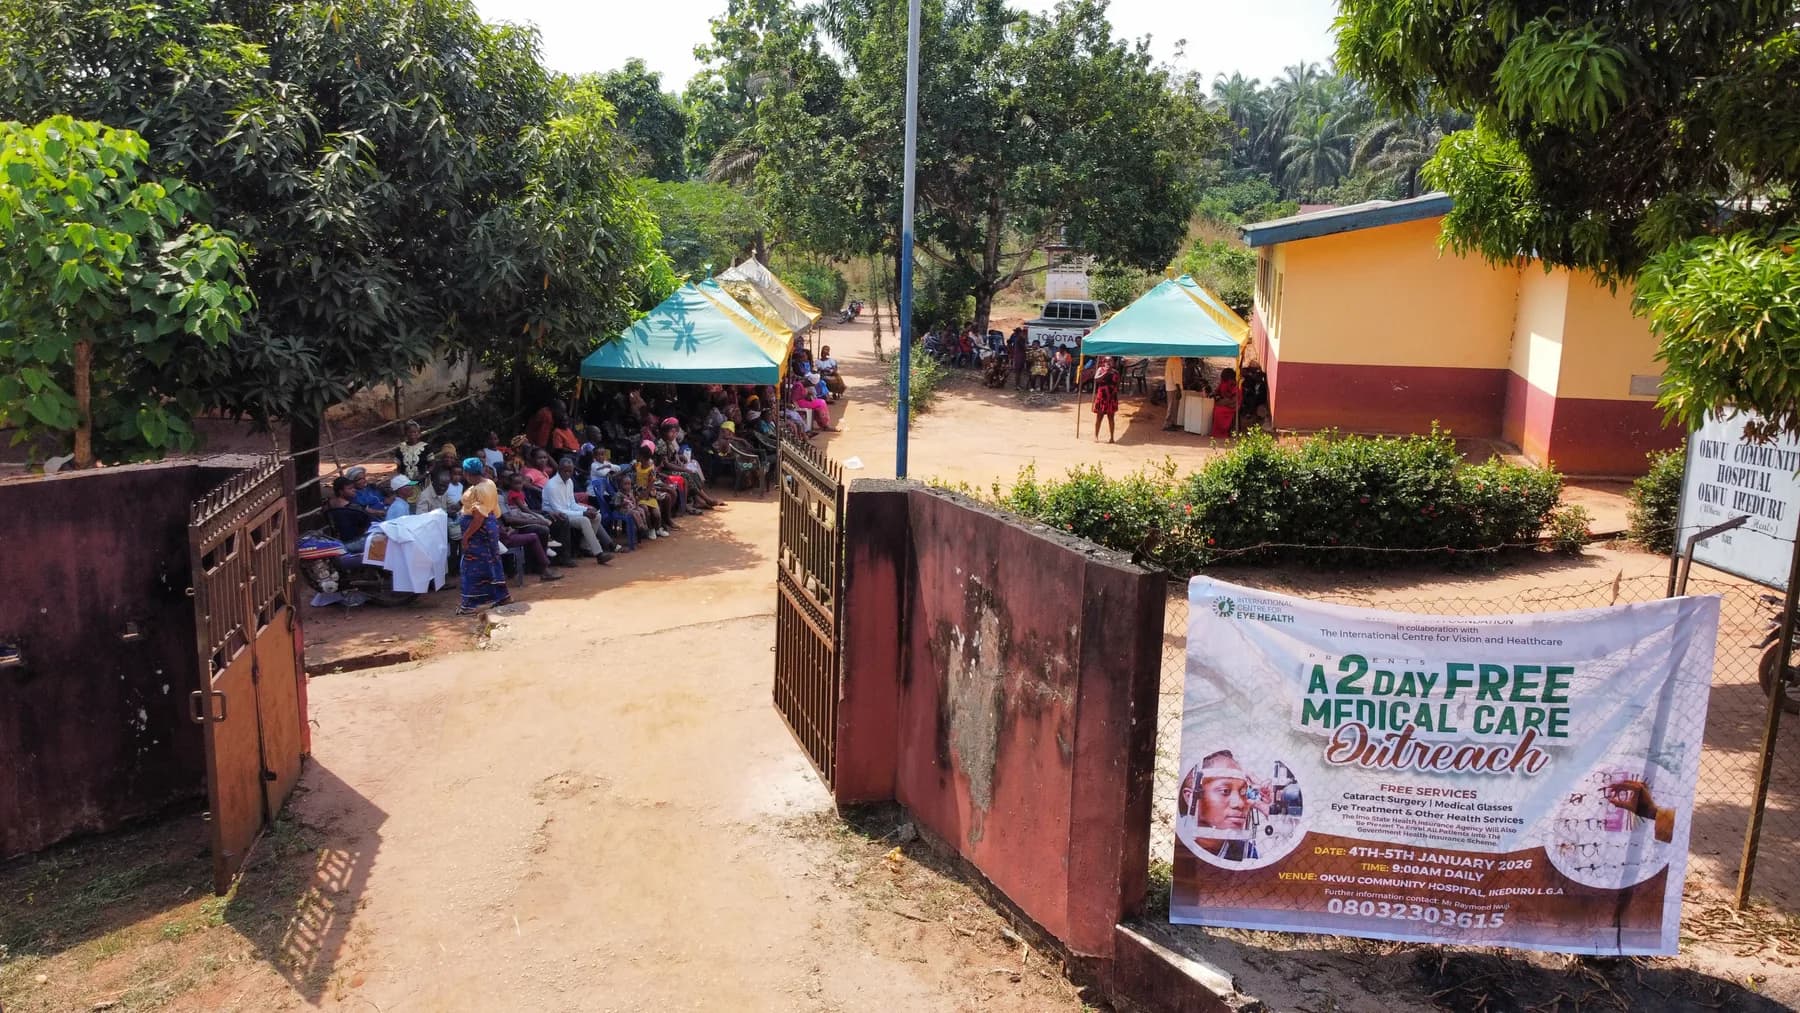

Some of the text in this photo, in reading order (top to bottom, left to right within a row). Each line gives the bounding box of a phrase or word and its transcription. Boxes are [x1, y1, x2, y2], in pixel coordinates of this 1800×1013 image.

[1036, 333, 1074, 342] TOYOTA
[1700, 440, 1729, 461] OKWU
[1717, 464, 1771, 493] HOSPITAL
[1698, 482, 1787, 521] OKWU IKEDURU
[1237, 603, 1266, 612] CENTRE
[1237, 611, 1295, 623] EYE HEALTH
[1320, 628, 1563, 647] The International Centre for Vision and Healthcare
[1405, 625, 1459, 634] collaboration
[1307, 653, 1575, 703] A 2 DAY FREE
[1301, 698, 1570, 738] MEDICAL CARE
[1326, 722, 1549, 774] Outreach
[1380, 783, 1478, 799] FREE SERVICES
[1342, 792, 1513, 812] Cataract Surgery Medical Glasses
[1331, 803, 1349, 812] Eye
[1351, 803, 1402, 815] Treatment
[1415, 809, 1444, 819] Other
[1446, 812, 1481, 823] Health
[1483, 815, 1524, 825] Services
[1357, 826, 1402, 837] Government
[1403, 831, 1428, 839] Health
[1429, 833, 1466, 843] Insurance
[1418, 819, 1455, 828] Insurance
[1455, 824, 1483, 833] Agency
[1314, 846, 1533, 871] DATE: 4TH-5TH JANUARY 2026
[1361, 862, 1485, 882] TIME: 9:00AM DAILY
[1278, 872, 1318, 881] VENUE:
[1319, 873, 1355, 883] OKWU
[1357, 876, 1427, 889] COMMUNITY
[1488, 887, 1536, 897] IKEDURU
[1325, 888, 1355, 897] Further
[1356, 889, 1405, 901] information
[1454, 901, 1492, 911] Raymond
[1327, 898, 1505, 930] 08032303615
